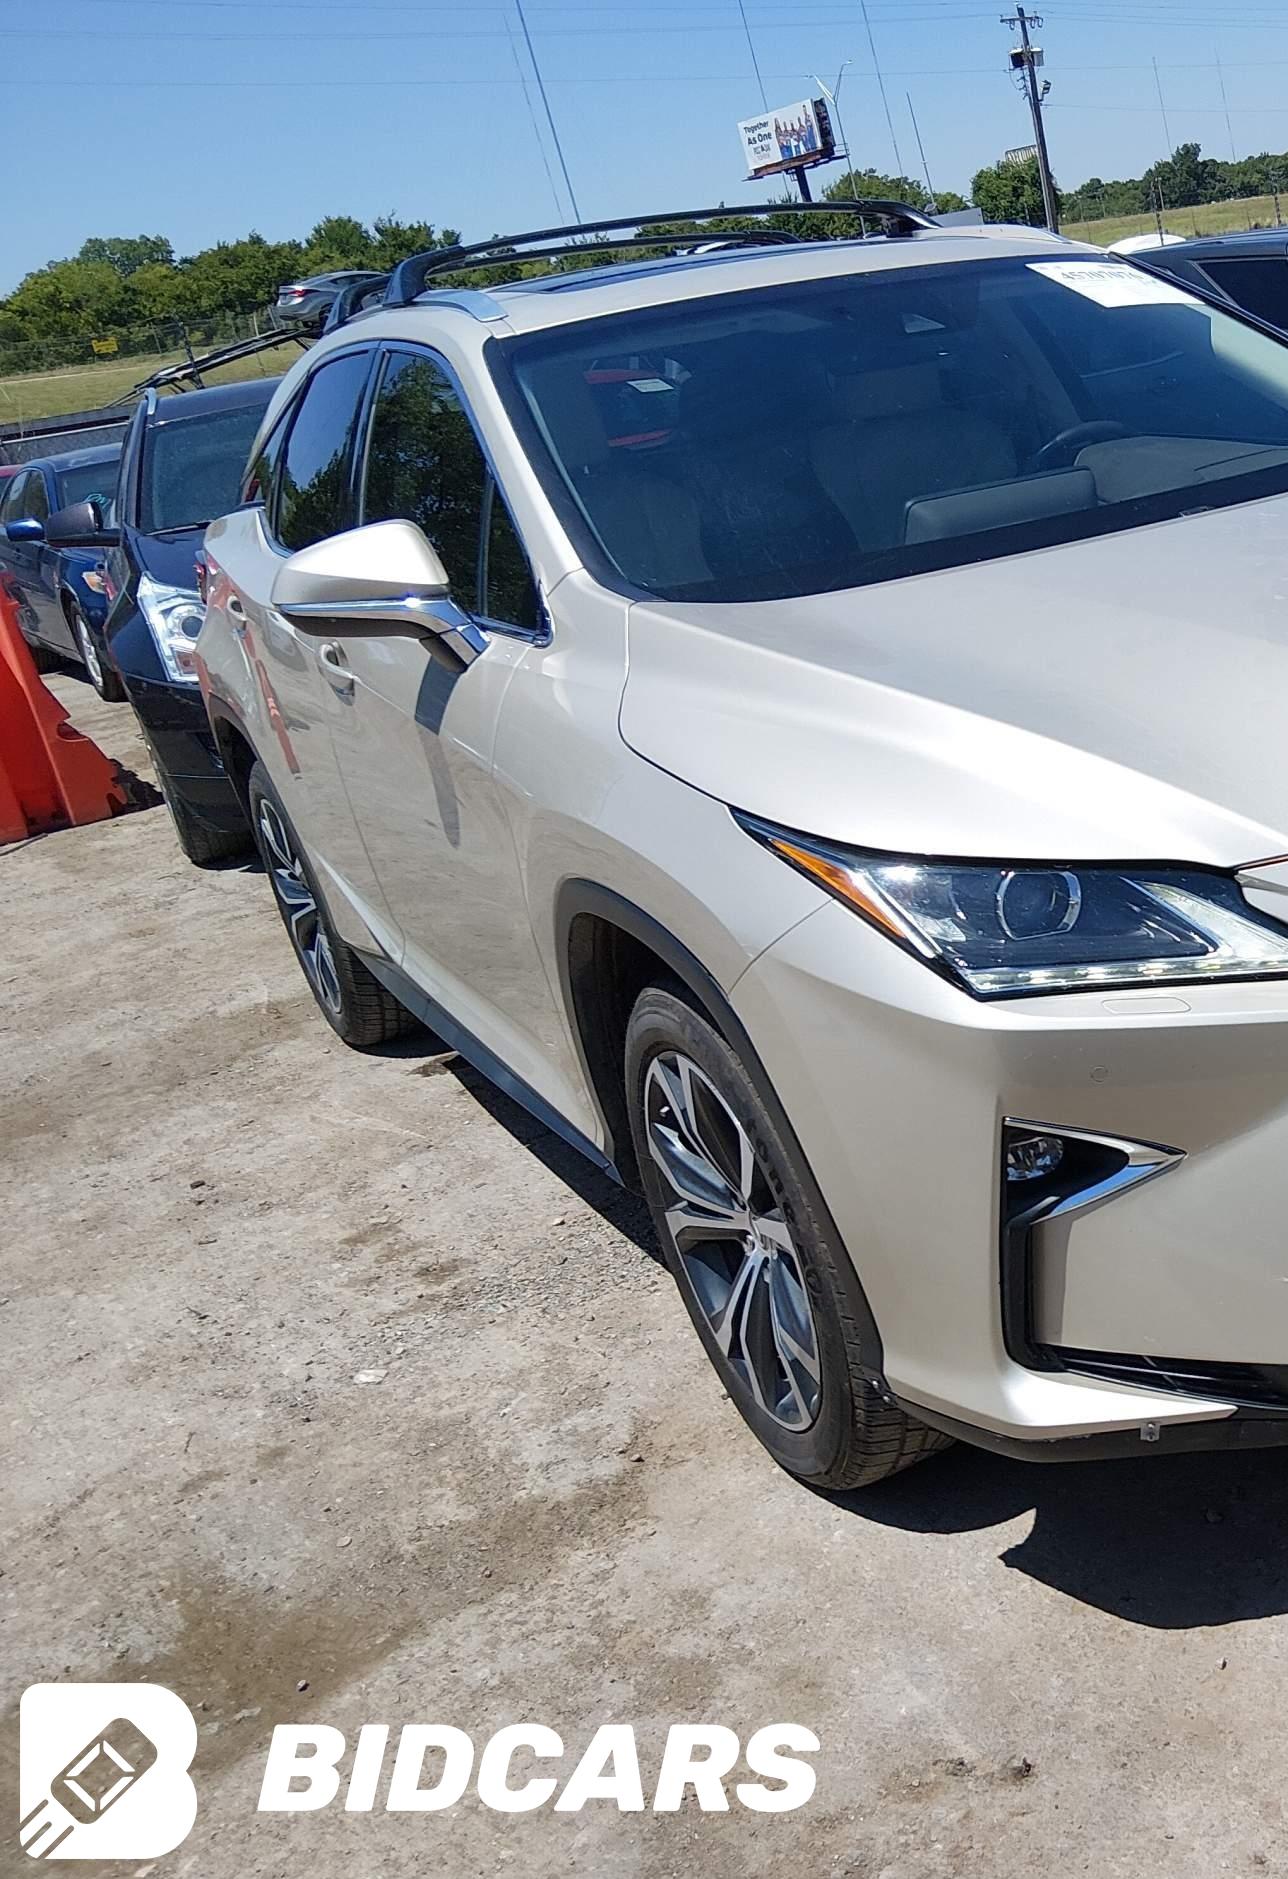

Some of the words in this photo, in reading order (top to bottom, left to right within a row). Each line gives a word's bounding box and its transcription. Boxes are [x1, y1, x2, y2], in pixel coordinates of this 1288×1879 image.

[743, 122, 769, 134] Together
[747, 136, 757, 145] As
[757, 133, 772, 143] One
